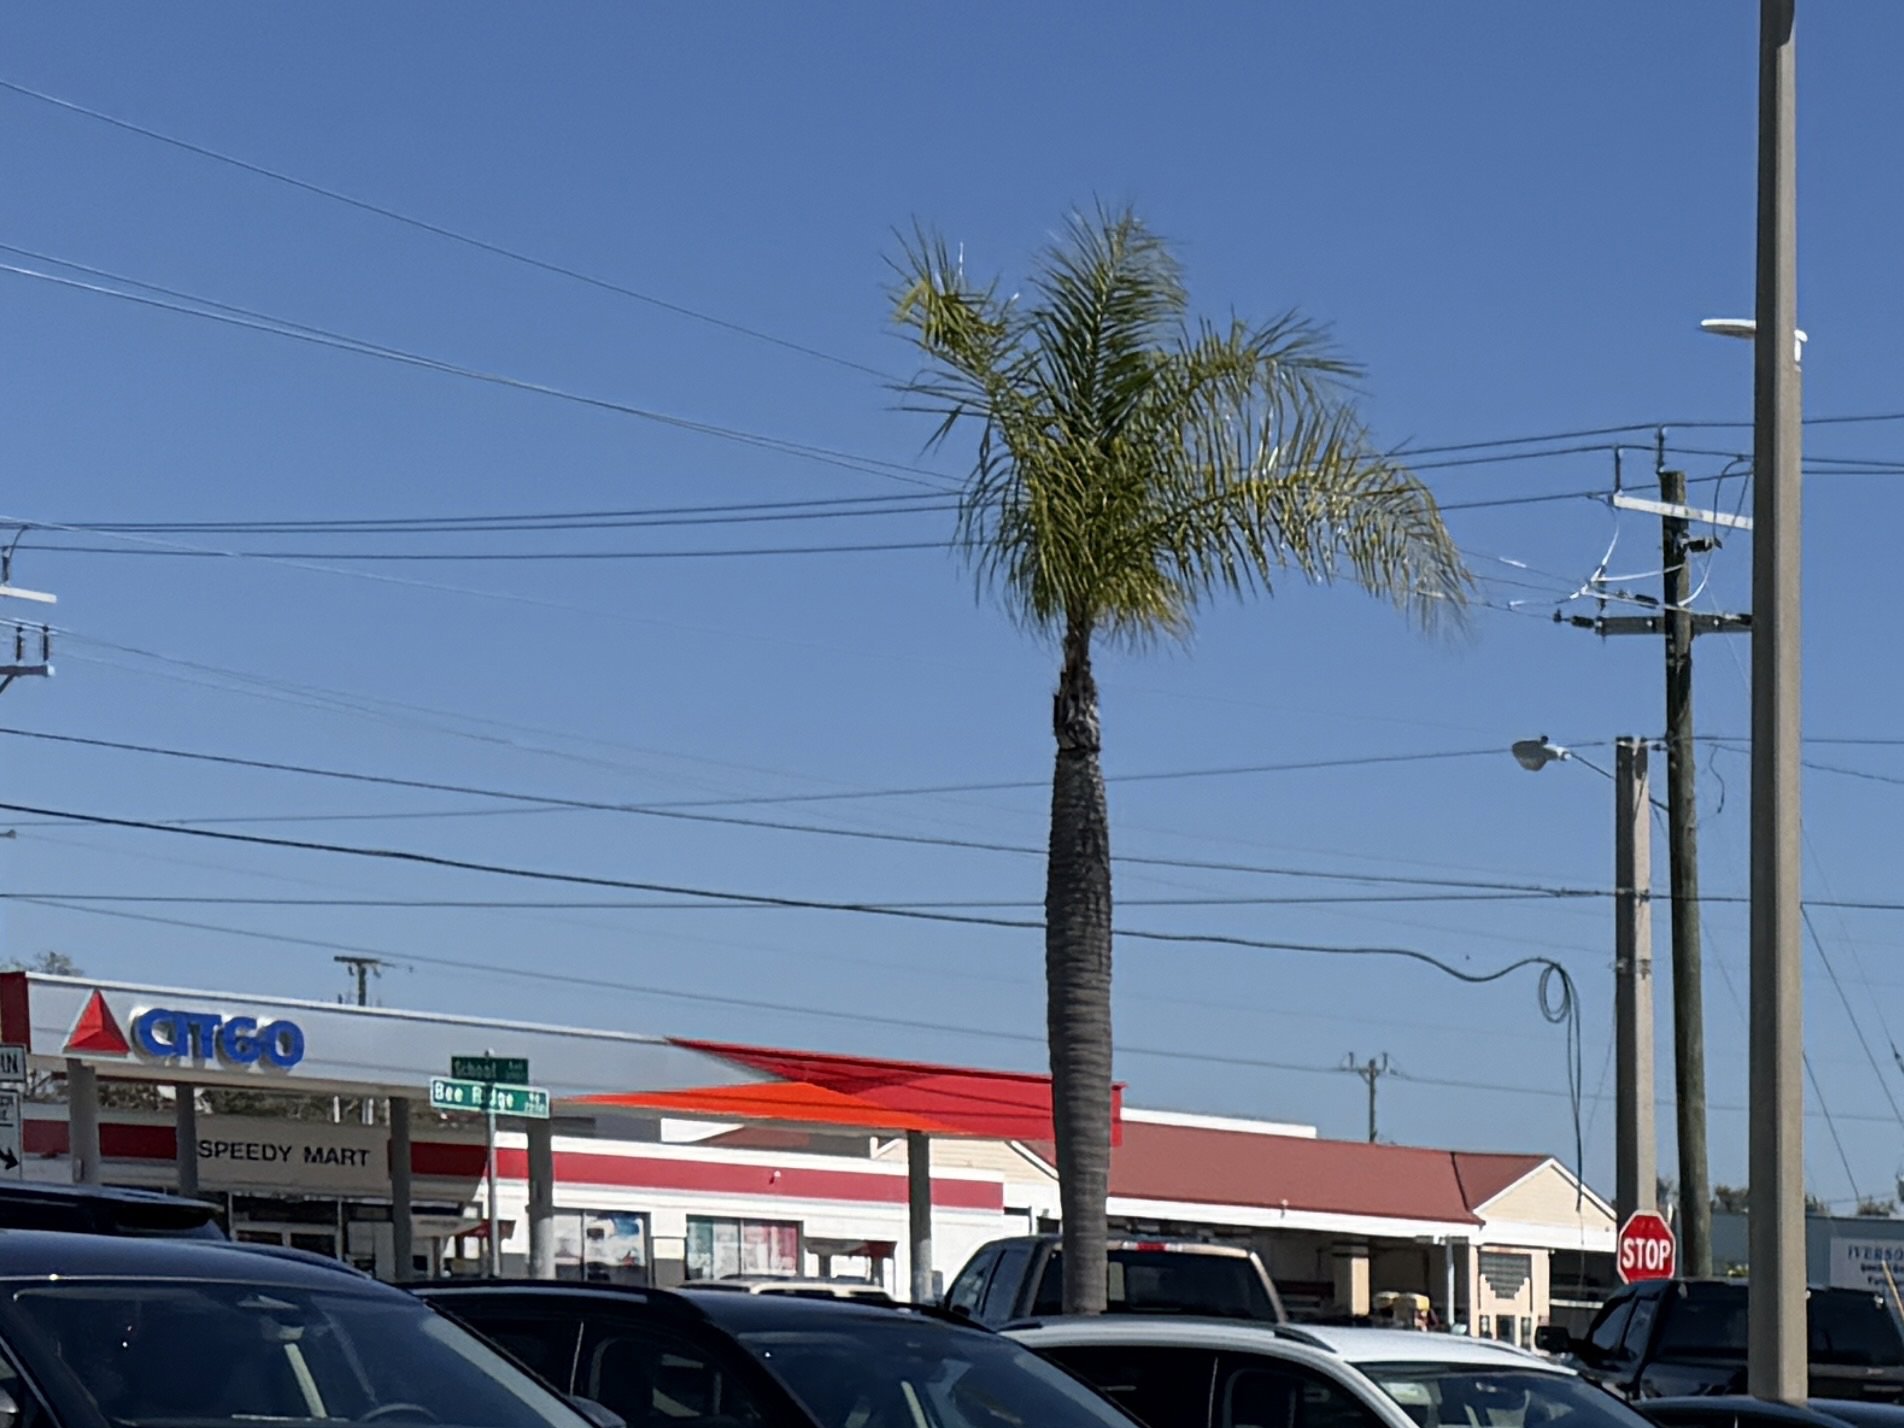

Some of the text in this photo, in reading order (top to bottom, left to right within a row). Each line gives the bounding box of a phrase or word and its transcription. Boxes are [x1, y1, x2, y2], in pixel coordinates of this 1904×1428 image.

[137, 1007, 305, 1068] CITGO
[434, 1081, 463, 1103] Bee
[472, 1085, 514, 1111] Rdge
[198, 1139, 371, 1167] SPEEDY MART
[1622, 1237, 1672, 1271] STOP
